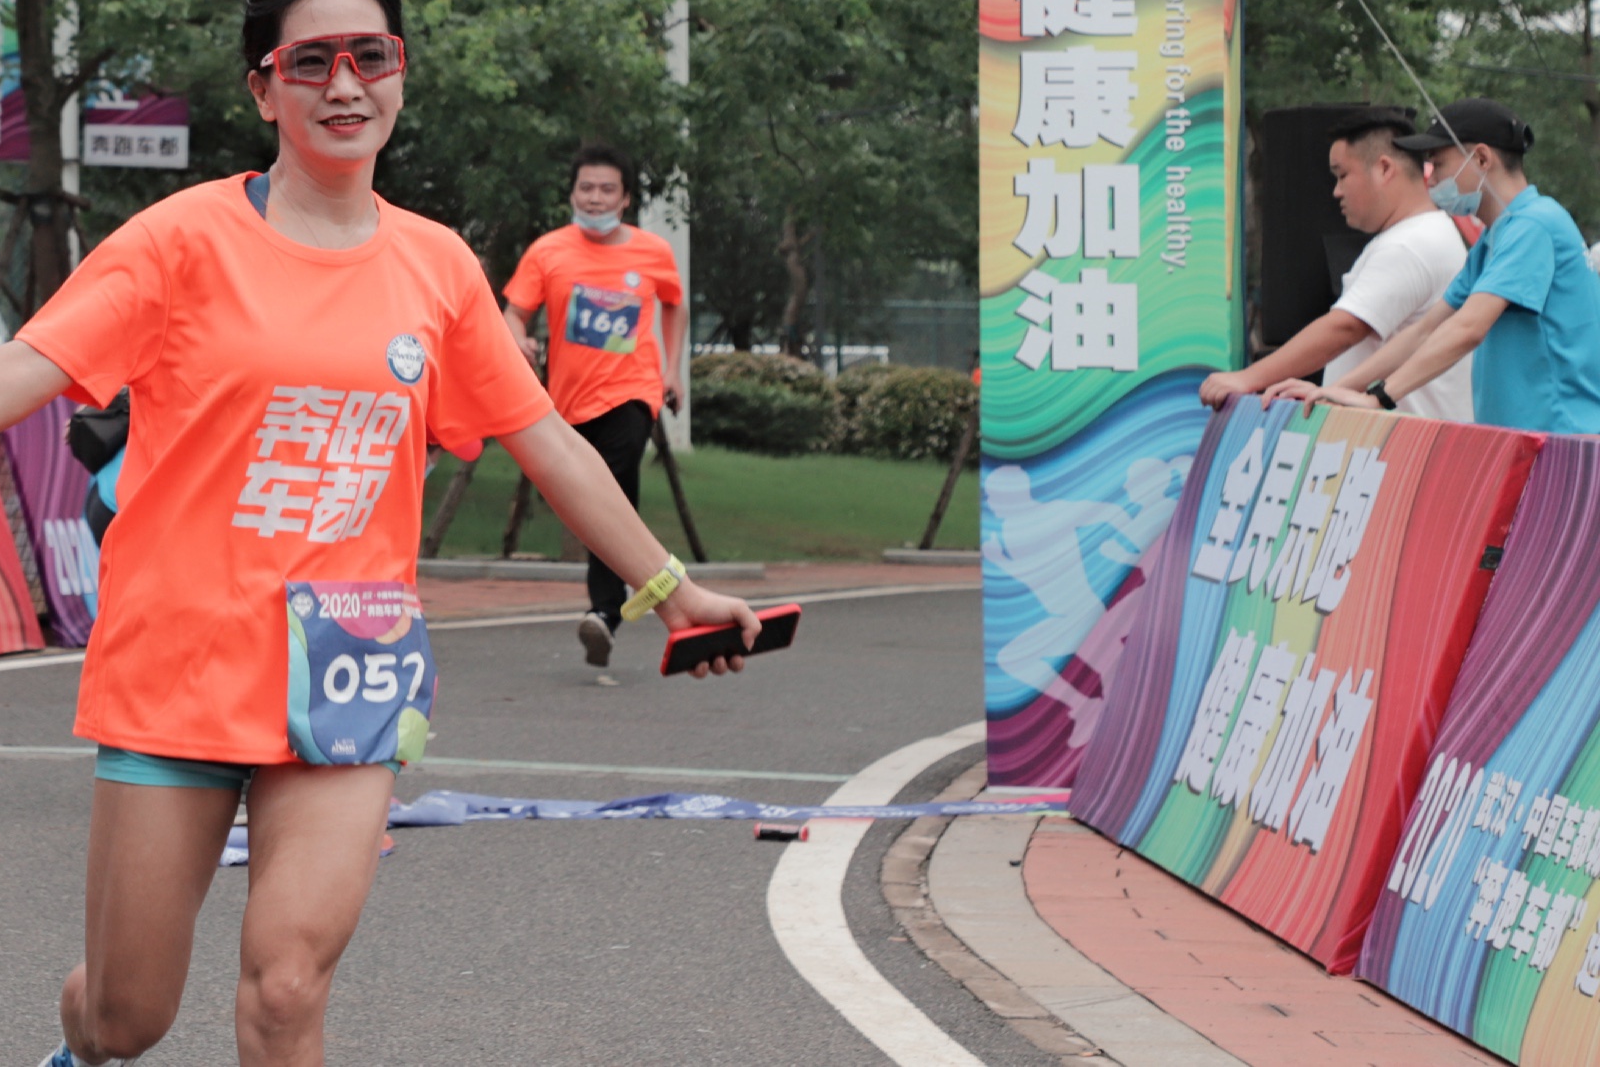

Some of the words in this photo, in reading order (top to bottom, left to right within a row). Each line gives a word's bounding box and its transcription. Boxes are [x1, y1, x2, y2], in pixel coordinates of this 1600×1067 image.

[1161, 165, 1193, 274] healthy.
[580, 309, 629, 336] 166
[255, 386, 410, 467] 奔跑
[232, 460, 390, 544] 车都
[1190, 427, 1388, 616] 全民乐跑
[318, 592, 361, 619] 2020
[323, 651, 425, 704] 057
[1172, 626, 1375, 856] 健康加油
[1387, 752, 1485, 912] 2020
